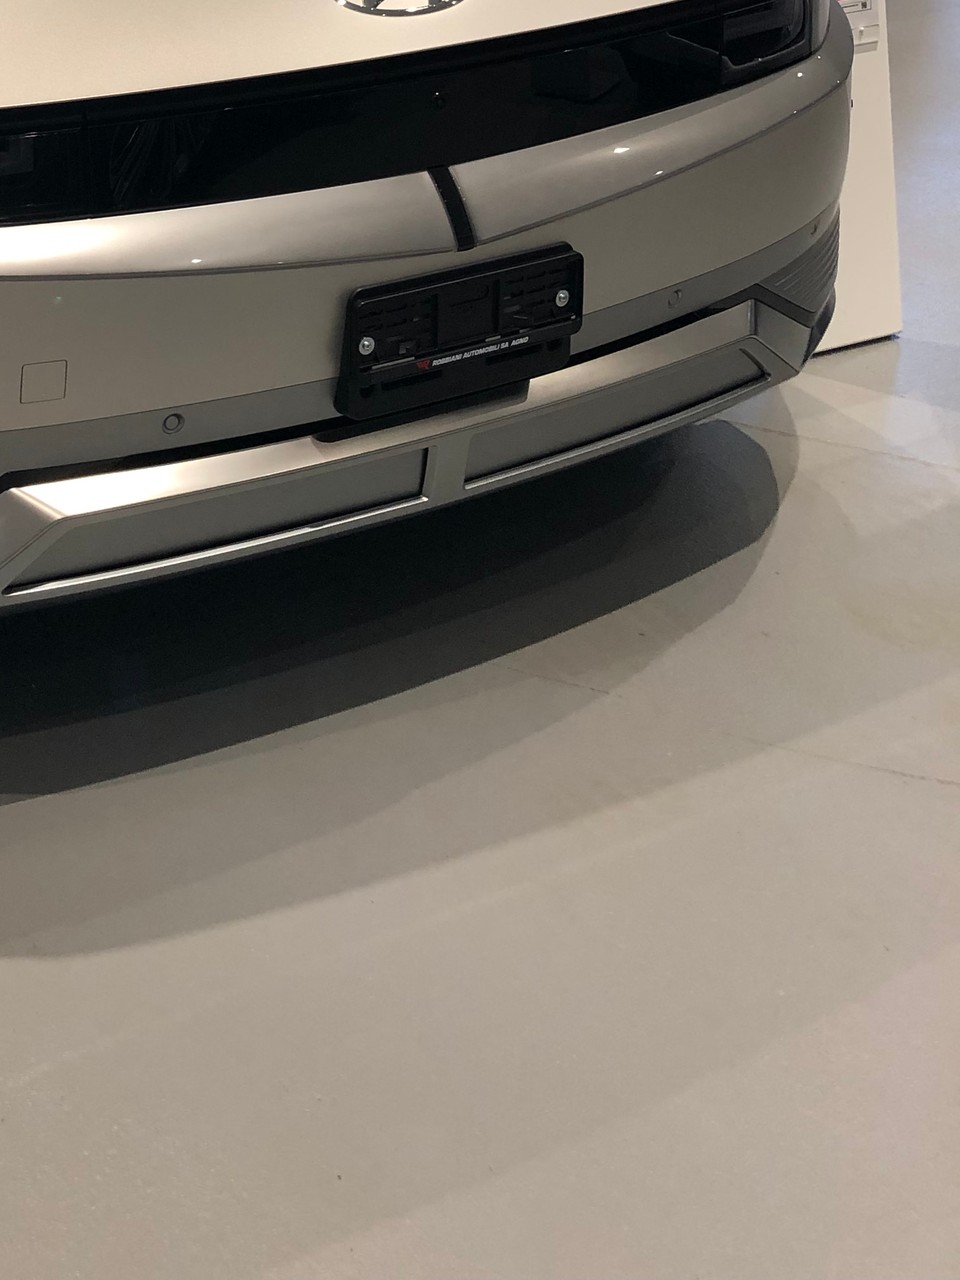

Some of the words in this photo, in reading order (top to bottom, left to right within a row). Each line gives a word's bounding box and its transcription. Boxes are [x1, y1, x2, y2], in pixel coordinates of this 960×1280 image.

[431, 353, 463, 367] ROBBIANI
[462, 343, 500, 359] AUTOMOBILI
[500, 341, 509, 349] SA
[510, 336, 530, 347] AGNO
